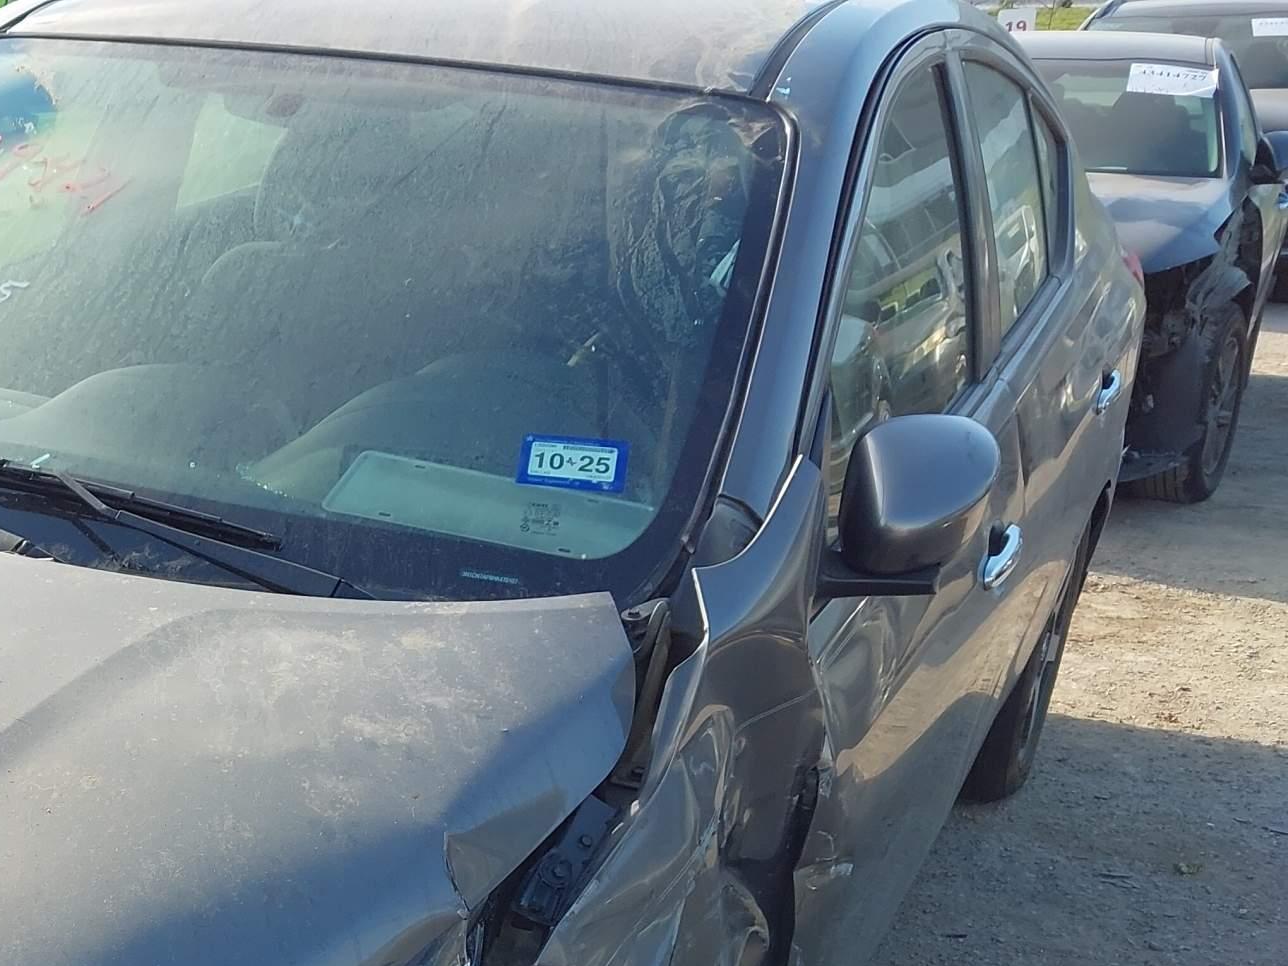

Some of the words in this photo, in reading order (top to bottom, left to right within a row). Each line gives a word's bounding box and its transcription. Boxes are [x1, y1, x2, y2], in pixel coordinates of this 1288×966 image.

[1005, 20, 1028, 32] 19
[534, 452, 564, 470] 10
[577, 455, 611, 475] 25
